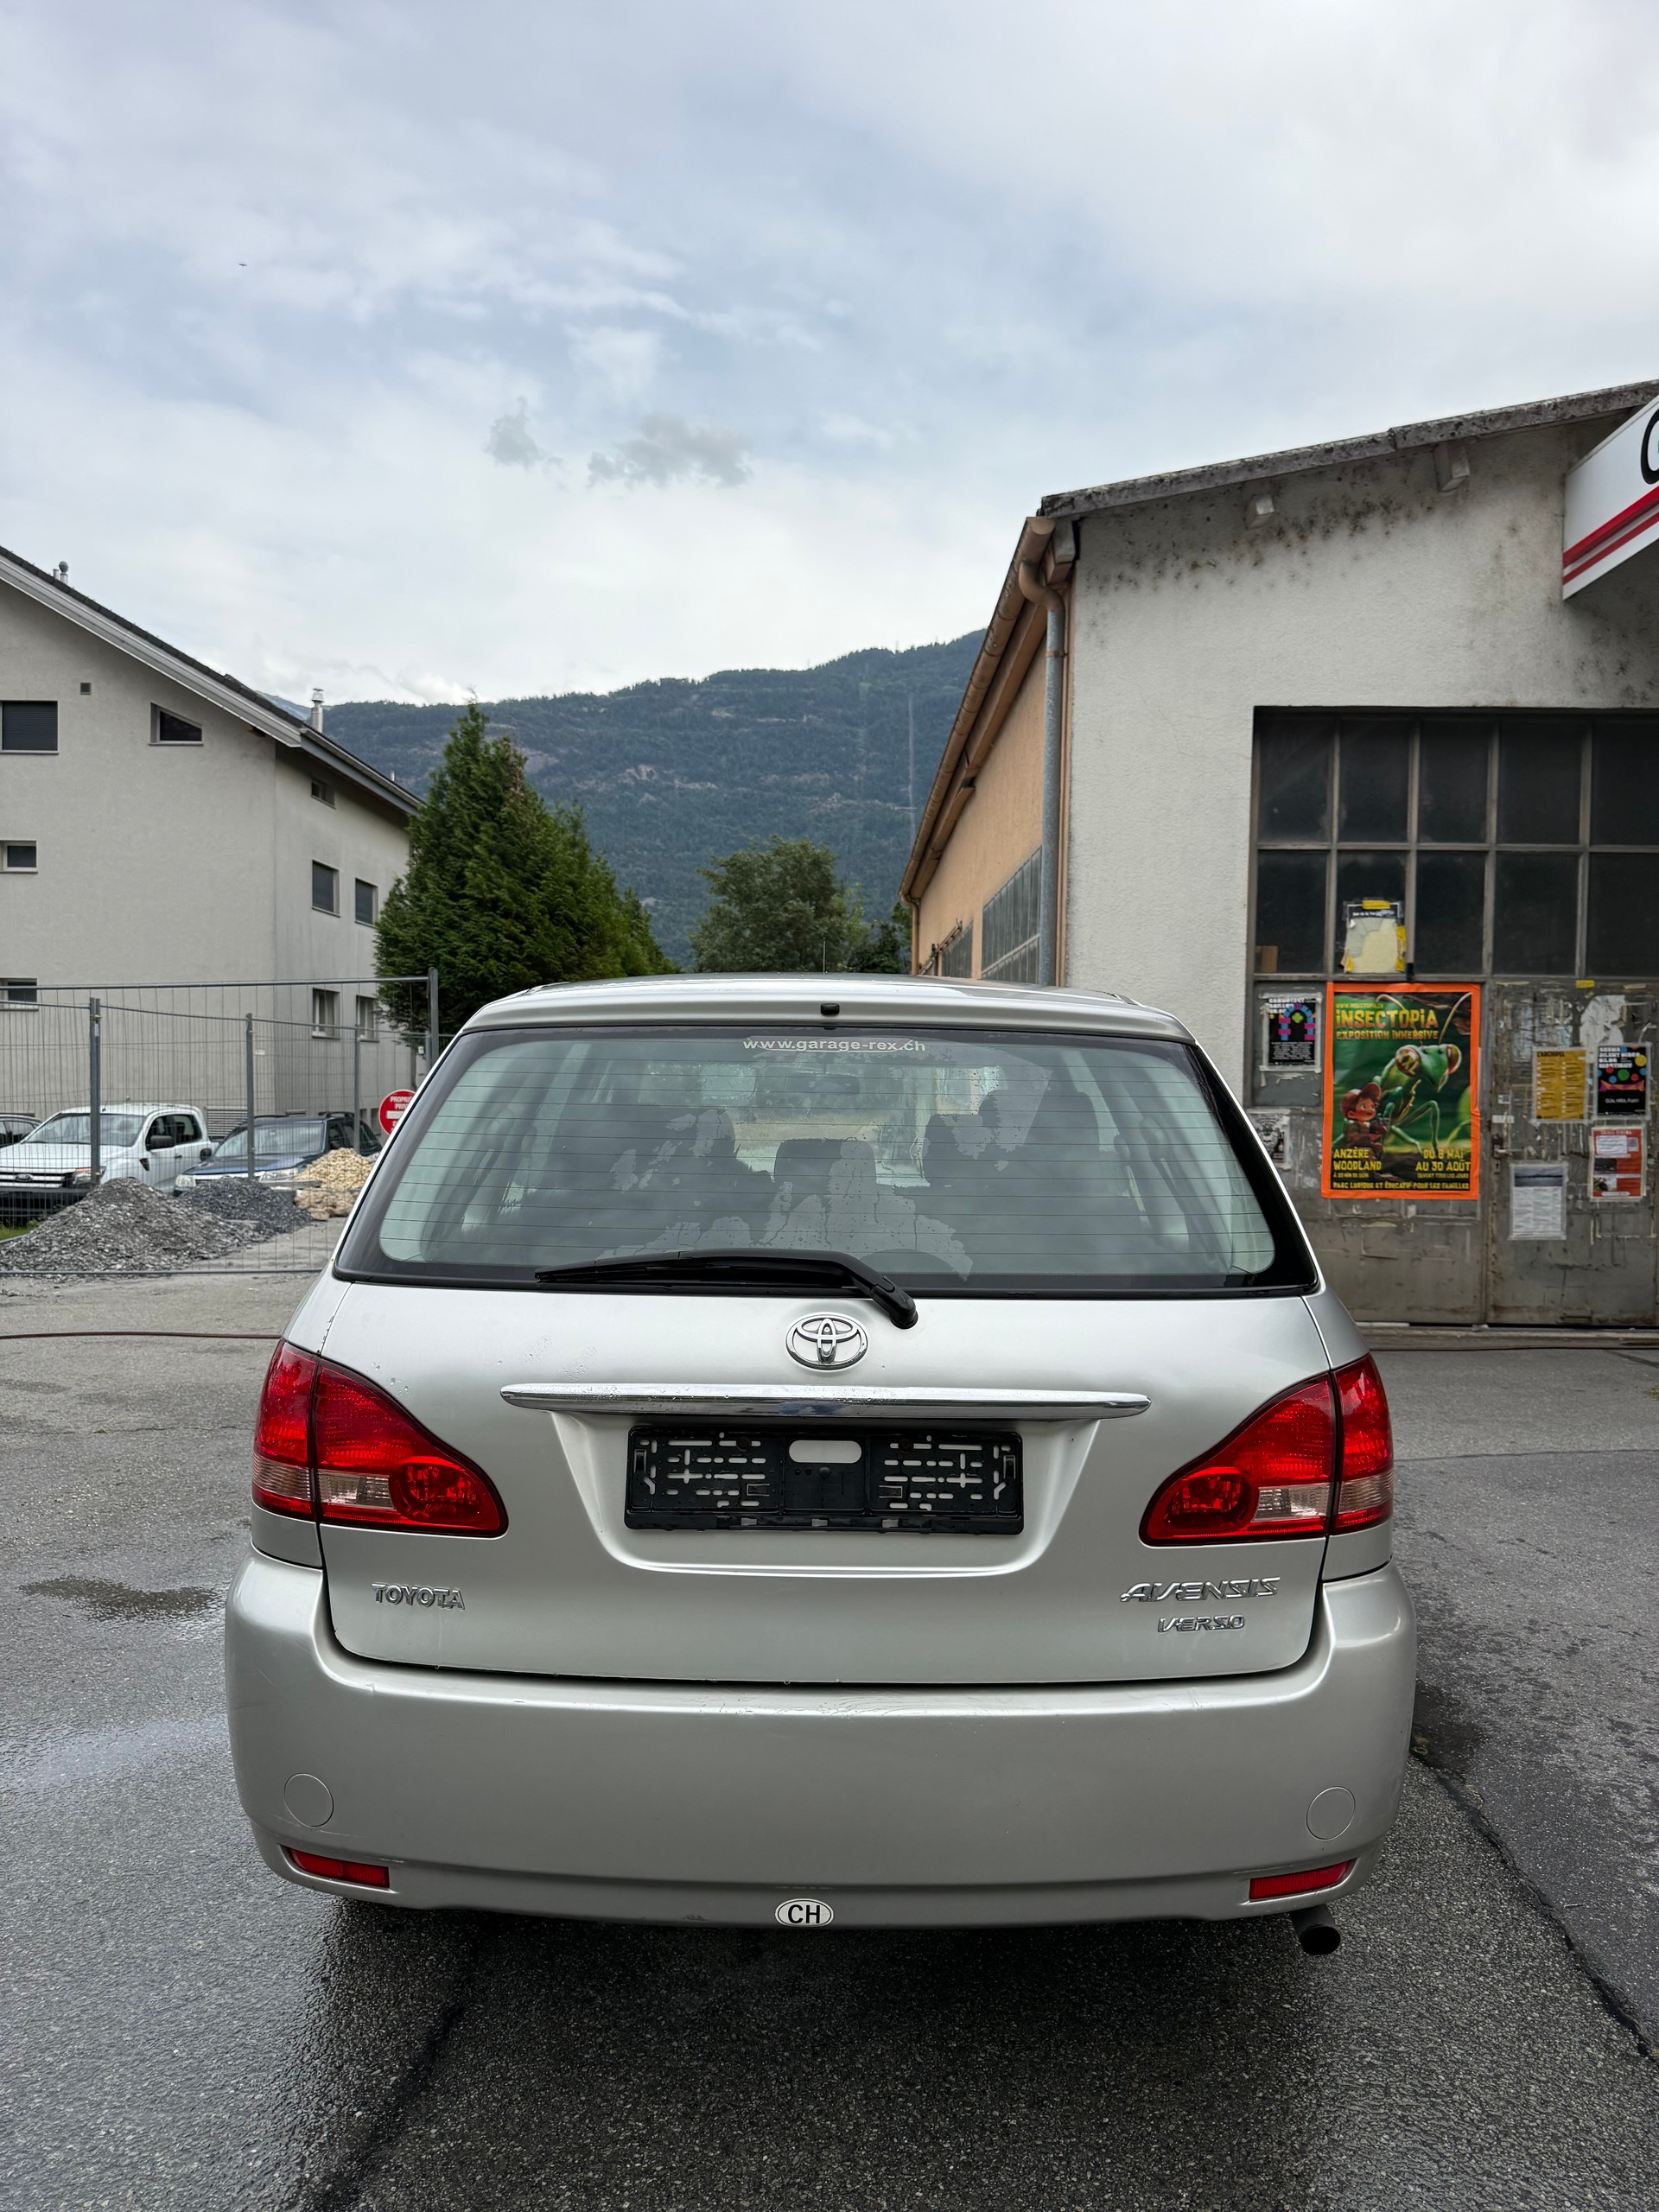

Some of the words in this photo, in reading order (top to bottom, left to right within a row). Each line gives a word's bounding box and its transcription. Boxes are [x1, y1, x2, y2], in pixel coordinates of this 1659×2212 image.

[743, 1039, 926, 1052] www.garage-rex.ch
[1333, 1147, 1369, 1159] ANZÈRE
[1423, 1149, 1435, 1160] DU
[1333, 1160, 1382, 1171] WOODLAND
[1415, 1161, 1429, 1172] AU
[1431, 1161, 1444, 1172] 30
[1446, 1159, 1471, 1172] AOÛT
[1120, 1576, 1281, 1602] AVENSIS
[372, 1583, 466, 1611] TOYOTA
[1158, 1614, 1245, 1633] VERSO
[787, 1904, 821, 1924] CH
